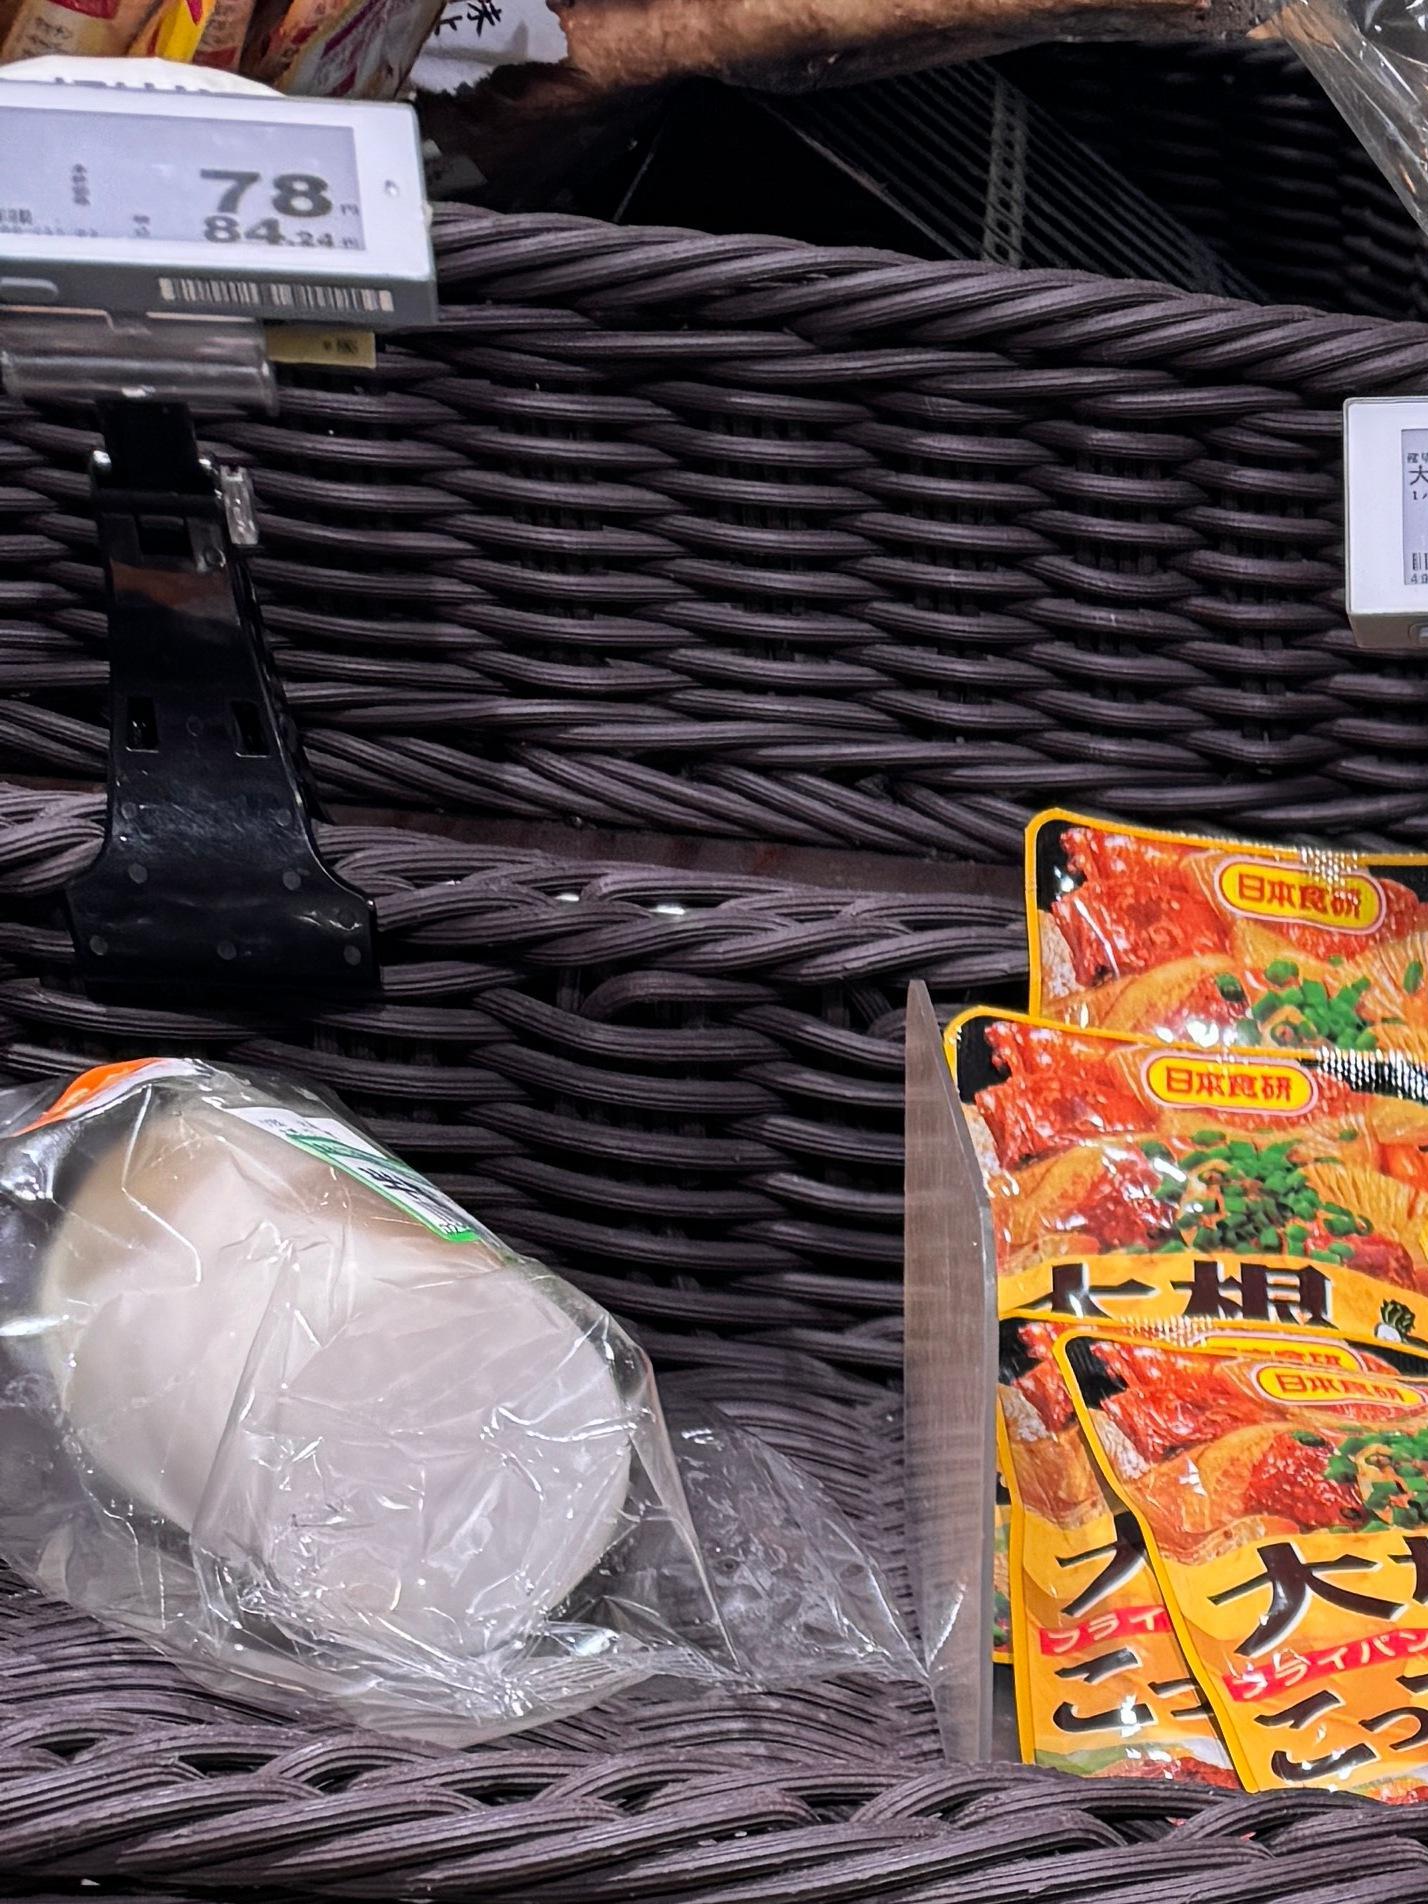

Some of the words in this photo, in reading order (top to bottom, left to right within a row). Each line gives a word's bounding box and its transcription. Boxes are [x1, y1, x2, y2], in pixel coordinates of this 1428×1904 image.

[1237, 871, 1365, 921] 日本食研
[1165, 1070, 1295, 1102] 日本食研
